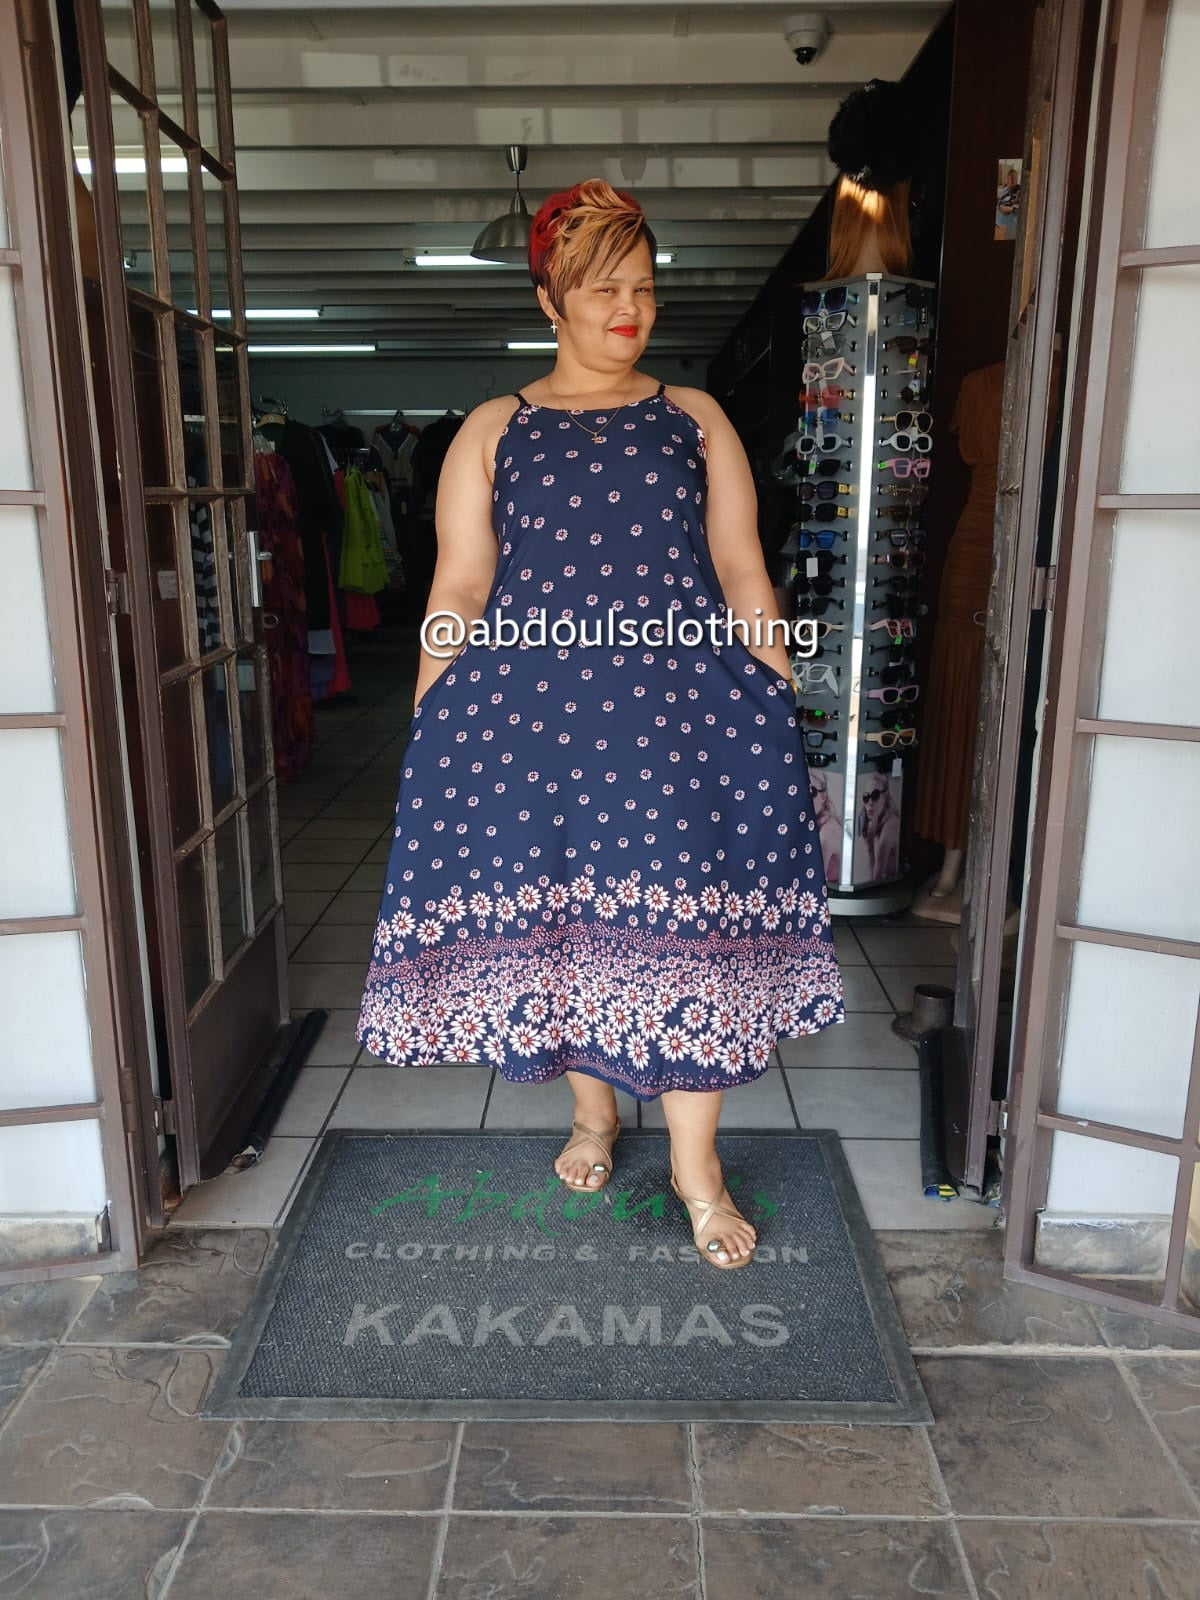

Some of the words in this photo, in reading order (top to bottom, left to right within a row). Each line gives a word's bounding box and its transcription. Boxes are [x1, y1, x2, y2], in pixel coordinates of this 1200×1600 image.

[370, 1169, 778, 1238] Abdou's
[345, 1242, 556, 1262] CLOTHING
[574, 1243, 599, 1262] &
[628, 1243, 808, 1264] FASON
[343, 1303, 790, 1347] KAKAMAS
